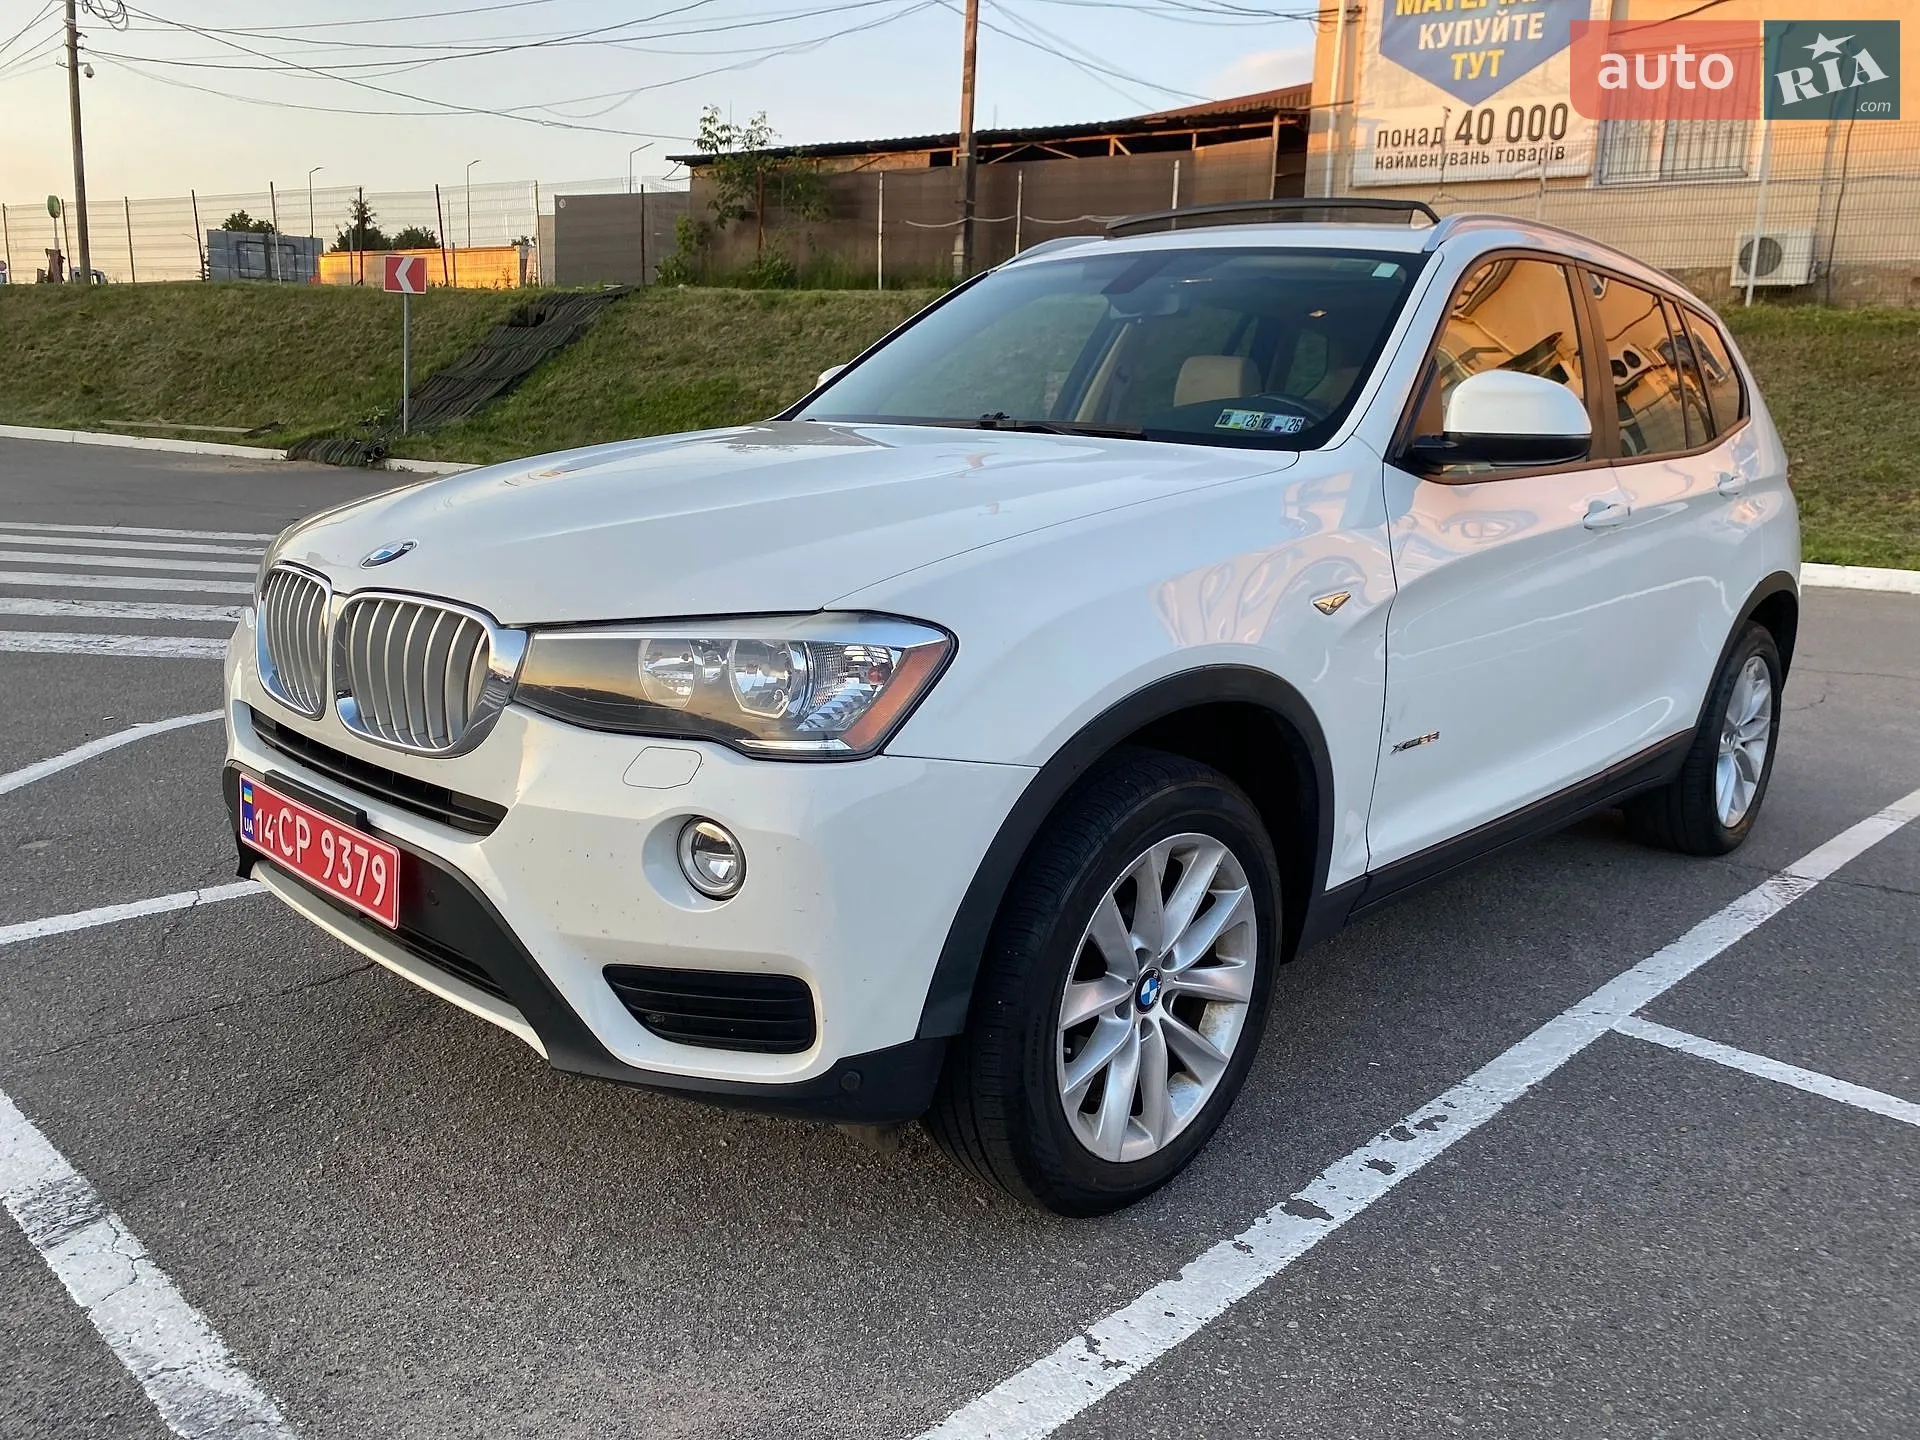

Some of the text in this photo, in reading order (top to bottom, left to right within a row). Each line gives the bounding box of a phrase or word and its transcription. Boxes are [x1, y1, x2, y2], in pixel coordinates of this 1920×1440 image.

[1418, 9, 1546, 50] КУПУЙТЕ
[1450, 48, 1505, 81] ТУТ
[1376, 102, 1569, 149] понад 40 000
[1375, 141, 1566, 171] найменувань товарів
[243, 816, 254, 835] UA
[320, 829, 387, 907] 9379
